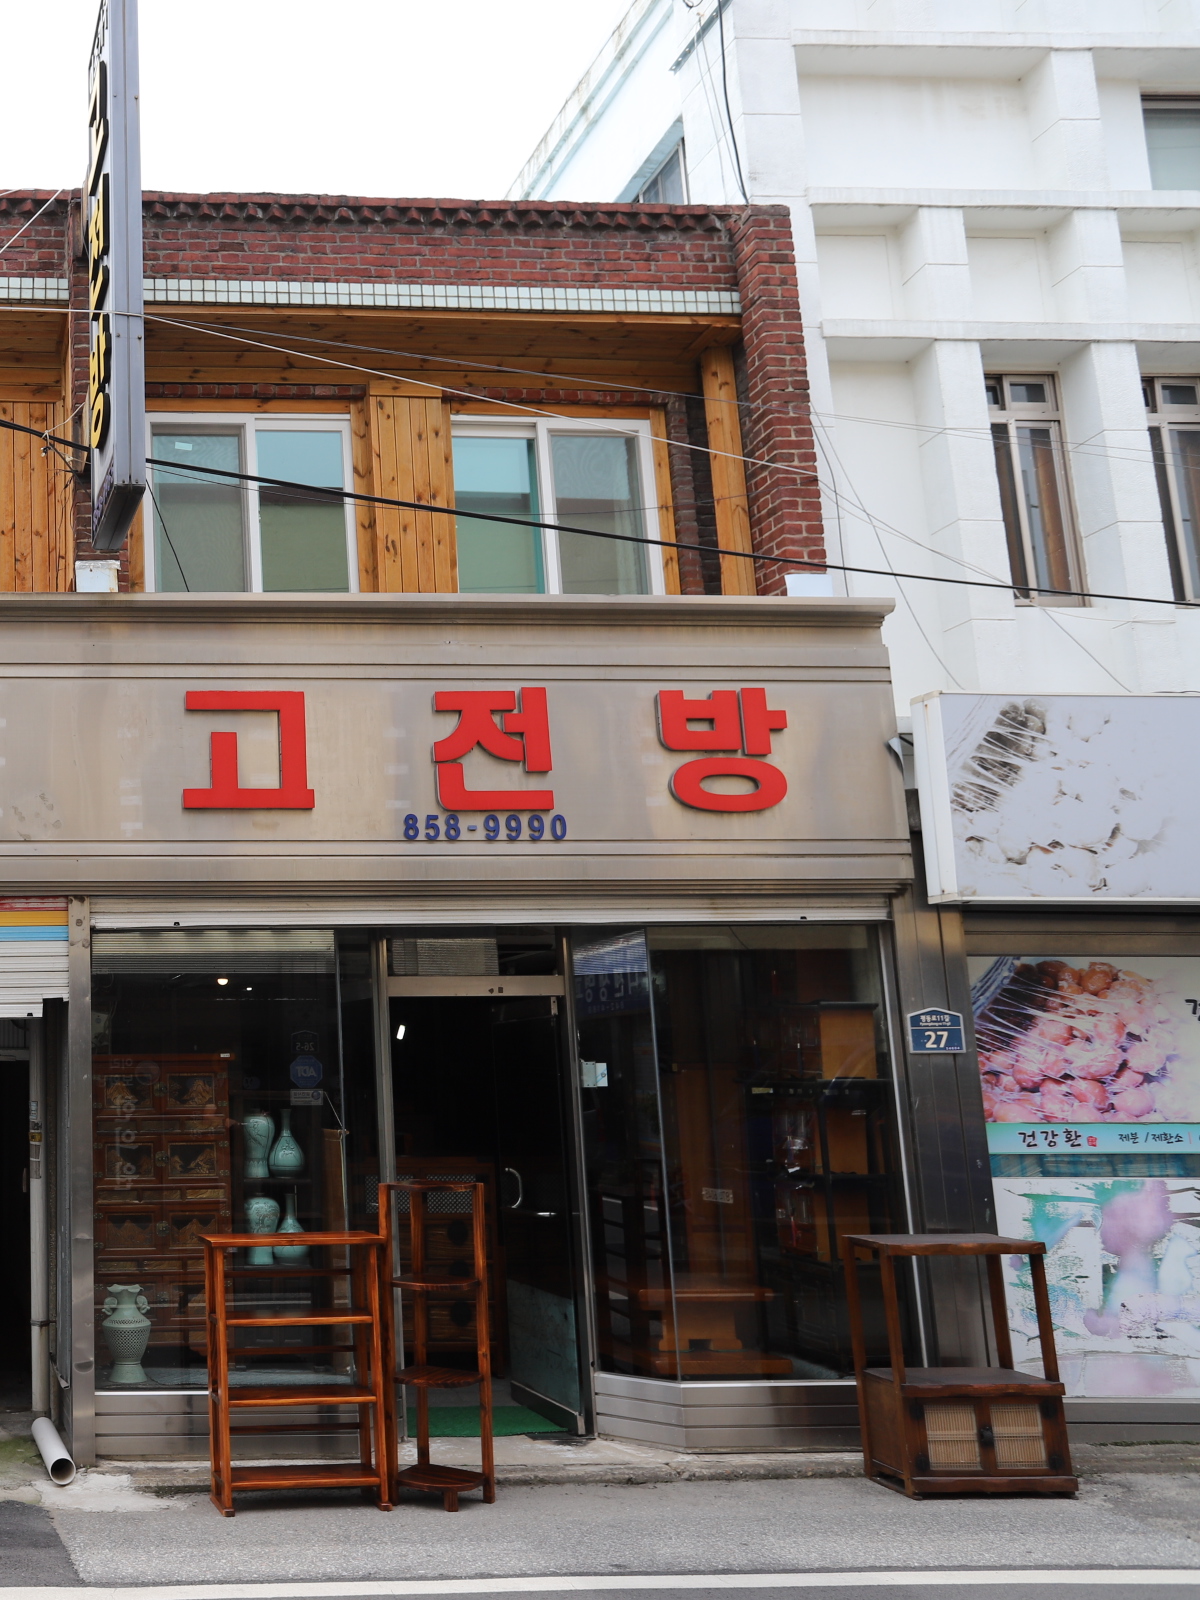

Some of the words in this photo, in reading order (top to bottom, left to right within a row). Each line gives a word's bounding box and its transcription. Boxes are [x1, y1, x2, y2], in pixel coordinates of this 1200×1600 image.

[402, 813, 569, 841] 858-9990
[919, 1014, 951, 1022] 평동로11길
[924, 1030, 949, 1048] 27
[1017, 1128, 1082, 1148] 건강환
[1118, 1132, 1139, 1144] 제분
